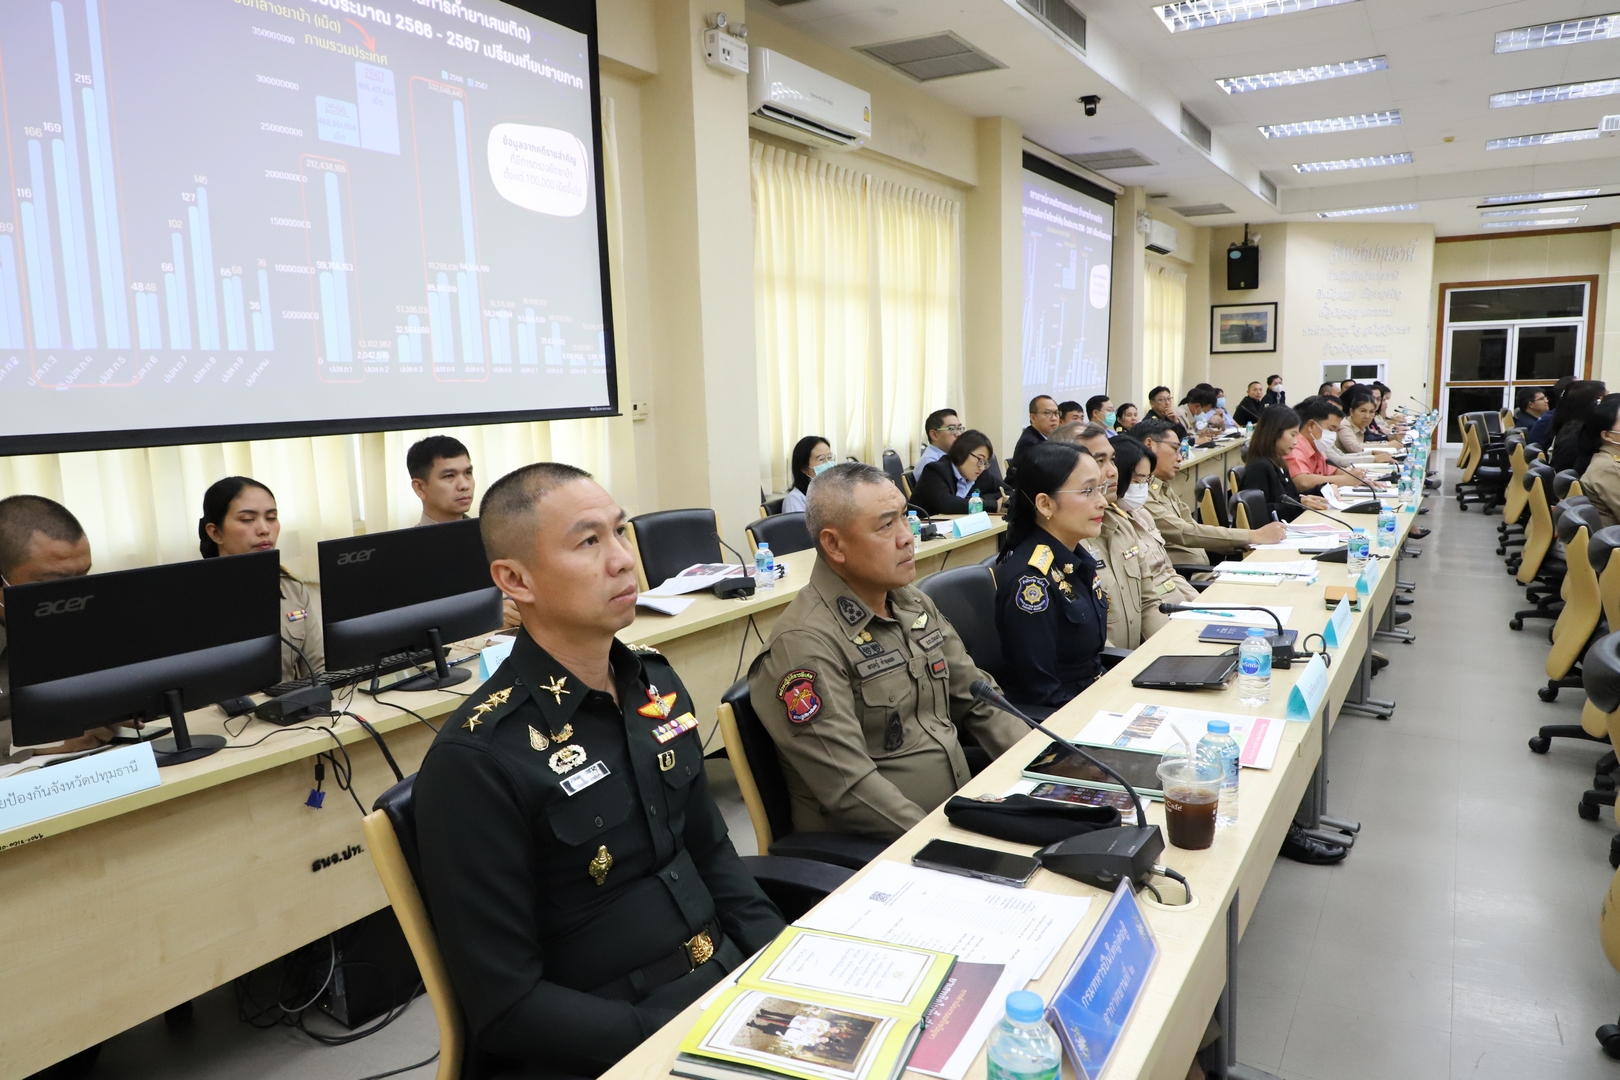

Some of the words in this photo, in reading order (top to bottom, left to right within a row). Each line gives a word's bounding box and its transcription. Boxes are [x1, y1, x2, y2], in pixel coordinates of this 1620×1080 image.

[314, 13, 341, 34] (เม็ด)
[412, 0, 531, 44] การค้ายาเสพติด)
[304, 33, 388, 66] ภาพรวมประเทศ
[395, 13, 433, 39] 2566
[446, 31, 480, 54] 2567
[483, 42, 584, 90] เปรียบเทียบรายภาค
[74, 73, 92, 85] 215
[24, 126, 42, 138] 166
[43, 121, 61, 133] 169
[194, 174, 208, 185] 145
[526, 174, 555, 190] 100,000
[16, 187, 32, 198] 116
[181, 192, 196, 202] 127
[168, 219, 183, 229] 102
[1329, 236, 1419, 270] จังหวัดปทุมธานี
[161, 262, 174, 272] 66
[256, 258, 267, 267] 76
[220, 267, 232, 277] 65
[232, 265, 243, 275] 68
[131, 283, 144, 292] 48
[145, 283, 157, 292] 48
[249, 301, 261, 310] 36
[318, 357, 324, 365] 0
[337, 548, 376, 566] acer
[34, 594, 94, 617] acer
[0, 759, 139, 809] ยป้องกันจังหวัดปทุมธานี
[1081, 919, 1130, 1009] กรมทหารปืนใหญ่ต่อสู้
[1103, 961, 1132, 1026] อากาศยานที่
